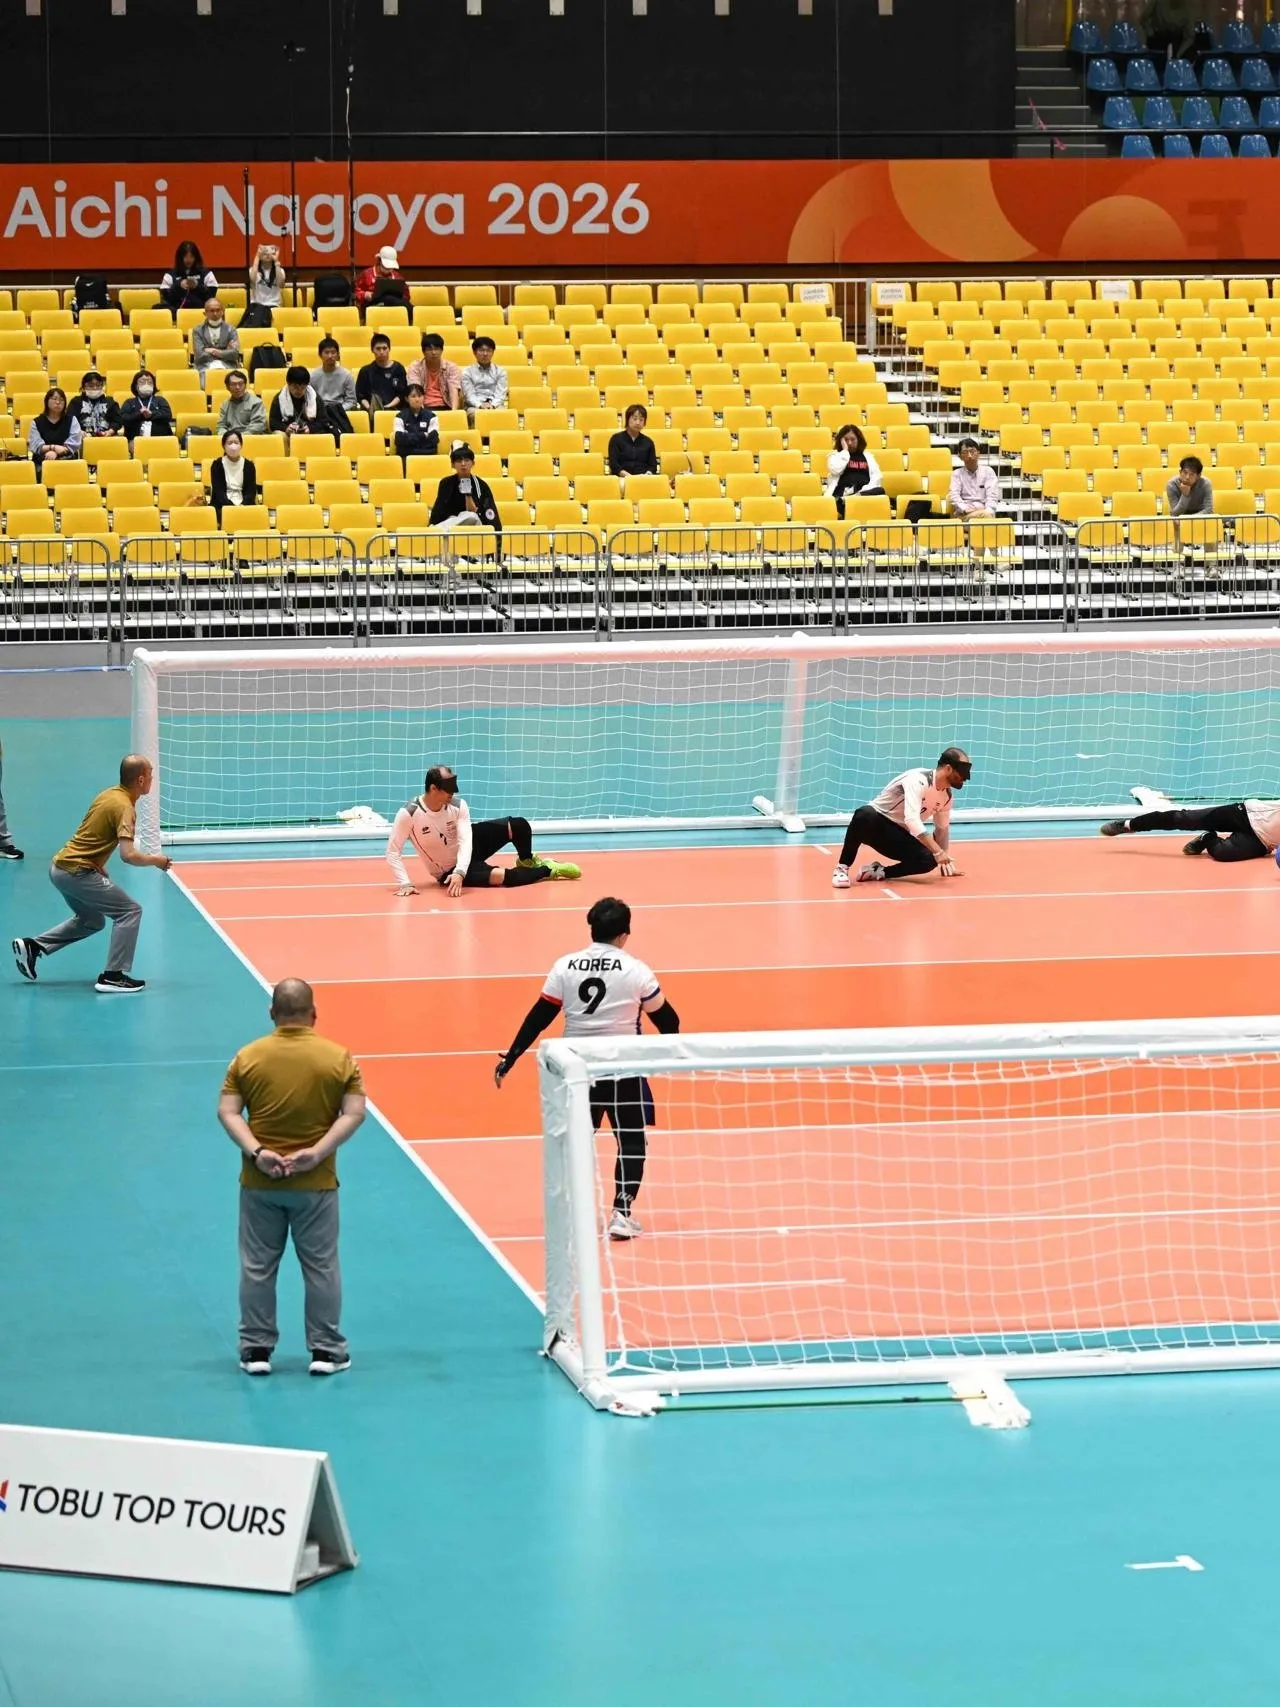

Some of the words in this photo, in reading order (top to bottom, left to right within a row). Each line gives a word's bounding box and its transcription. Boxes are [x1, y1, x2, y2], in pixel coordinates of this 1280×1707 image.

[4, 179, 464, 254] Aichi-Nagoya
[487, 182, 651, 236] 2026
[567, 958, 623, 971] KOREA
[578, 977, 607, 1015] 9
[18, 1483, 103, 1518] TOBU
[113, 1492, 175, 1524] TOP
[184, 1499, 287, 1536] TOURS
